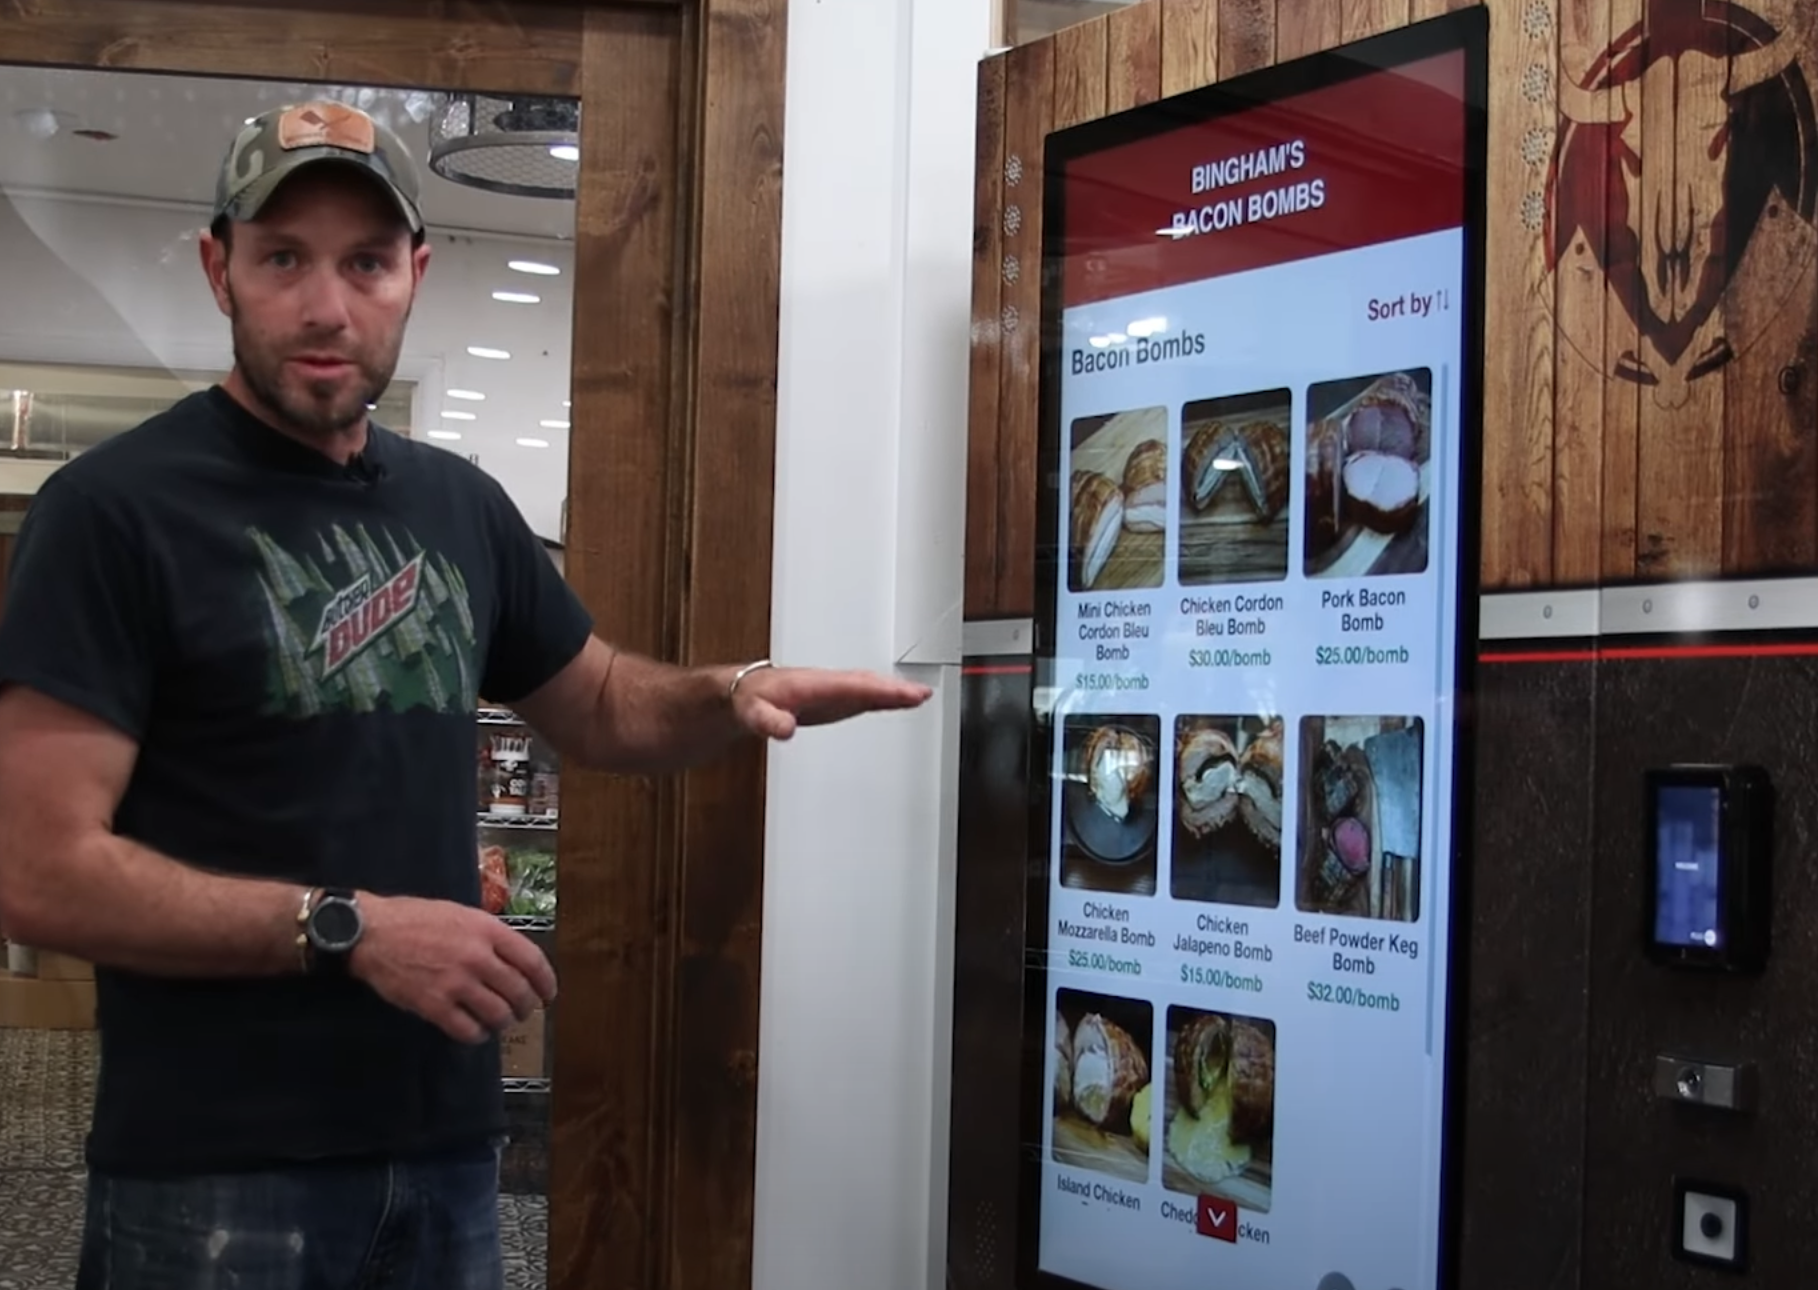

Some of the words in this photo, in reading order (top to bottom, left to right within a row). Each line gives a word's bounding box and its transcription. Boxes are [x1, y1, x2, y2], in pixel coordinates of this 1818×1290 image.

[1191, 140, 1305, 194] BINGHAM'S
[1172, 198, 1243, 240] BACON
[1247, 179, 1325, 222] BOMBS
[1367, 296, 1405, 321] Sort
[1411, 291, 1431, 317] by
[1071, 346, 1130, 375] Bacon
[1136, 330, 1205, 364] Bombs
[1078, 603, 1101, 619] Mini
[1104, 602, 1151, 617] Chicken
[1180, 596, 1231, 614] Chicken
[1235, 595, 1283, 612] Cordon
[1322, 590, 1354, 609] Pork
[1359, 589, 1405, 607] Bacon
[1078, 624, 1120, 640] Cordon
[1123, 623, 1149, 639] Bleu
[1196, 619, 1224, 636] Bleu
[1228, 618, 1266, 635] Bomb
[1341, 613, 1384, 632] Bomb
[1096, 645, 1130, 661] Bomb
[1188, 649, 1271, 667] $30.00/bomb
[1316, 646, 1409, 665] $25.00/bomb
[1076, 673, 1149, 691] $15.00/bomb
[1083, 901, 1129, 922] Chicken
[1057, 920, 1118, 943] Mozzarella
[1121, 929, 1156, 948] Bomb
[1197, 914, 1248, 937] Chicken
[1173, 934, 1230, 957] Jalapeno
[1234, 943, 1273, 963] Bomb
[1294, 924, 1325, 943] Beef
[1329, 931, 1384, 952] Powder
[1389, 934, 1419, 959] Keg
[1068, 949, 1142, 976] $25.00/bomb
[1333, 952, 1376, 974] Bomb
[1180, 964, 1263, 992] $15.00/bomb
[1307, 982, 1400, 1012] $32.00/bomb
[1057, 1174, 1091, 1197] Island
[1094, 1184, 1141, 1211] Chicken
[1238, 1221, 1270, 1244] cken
